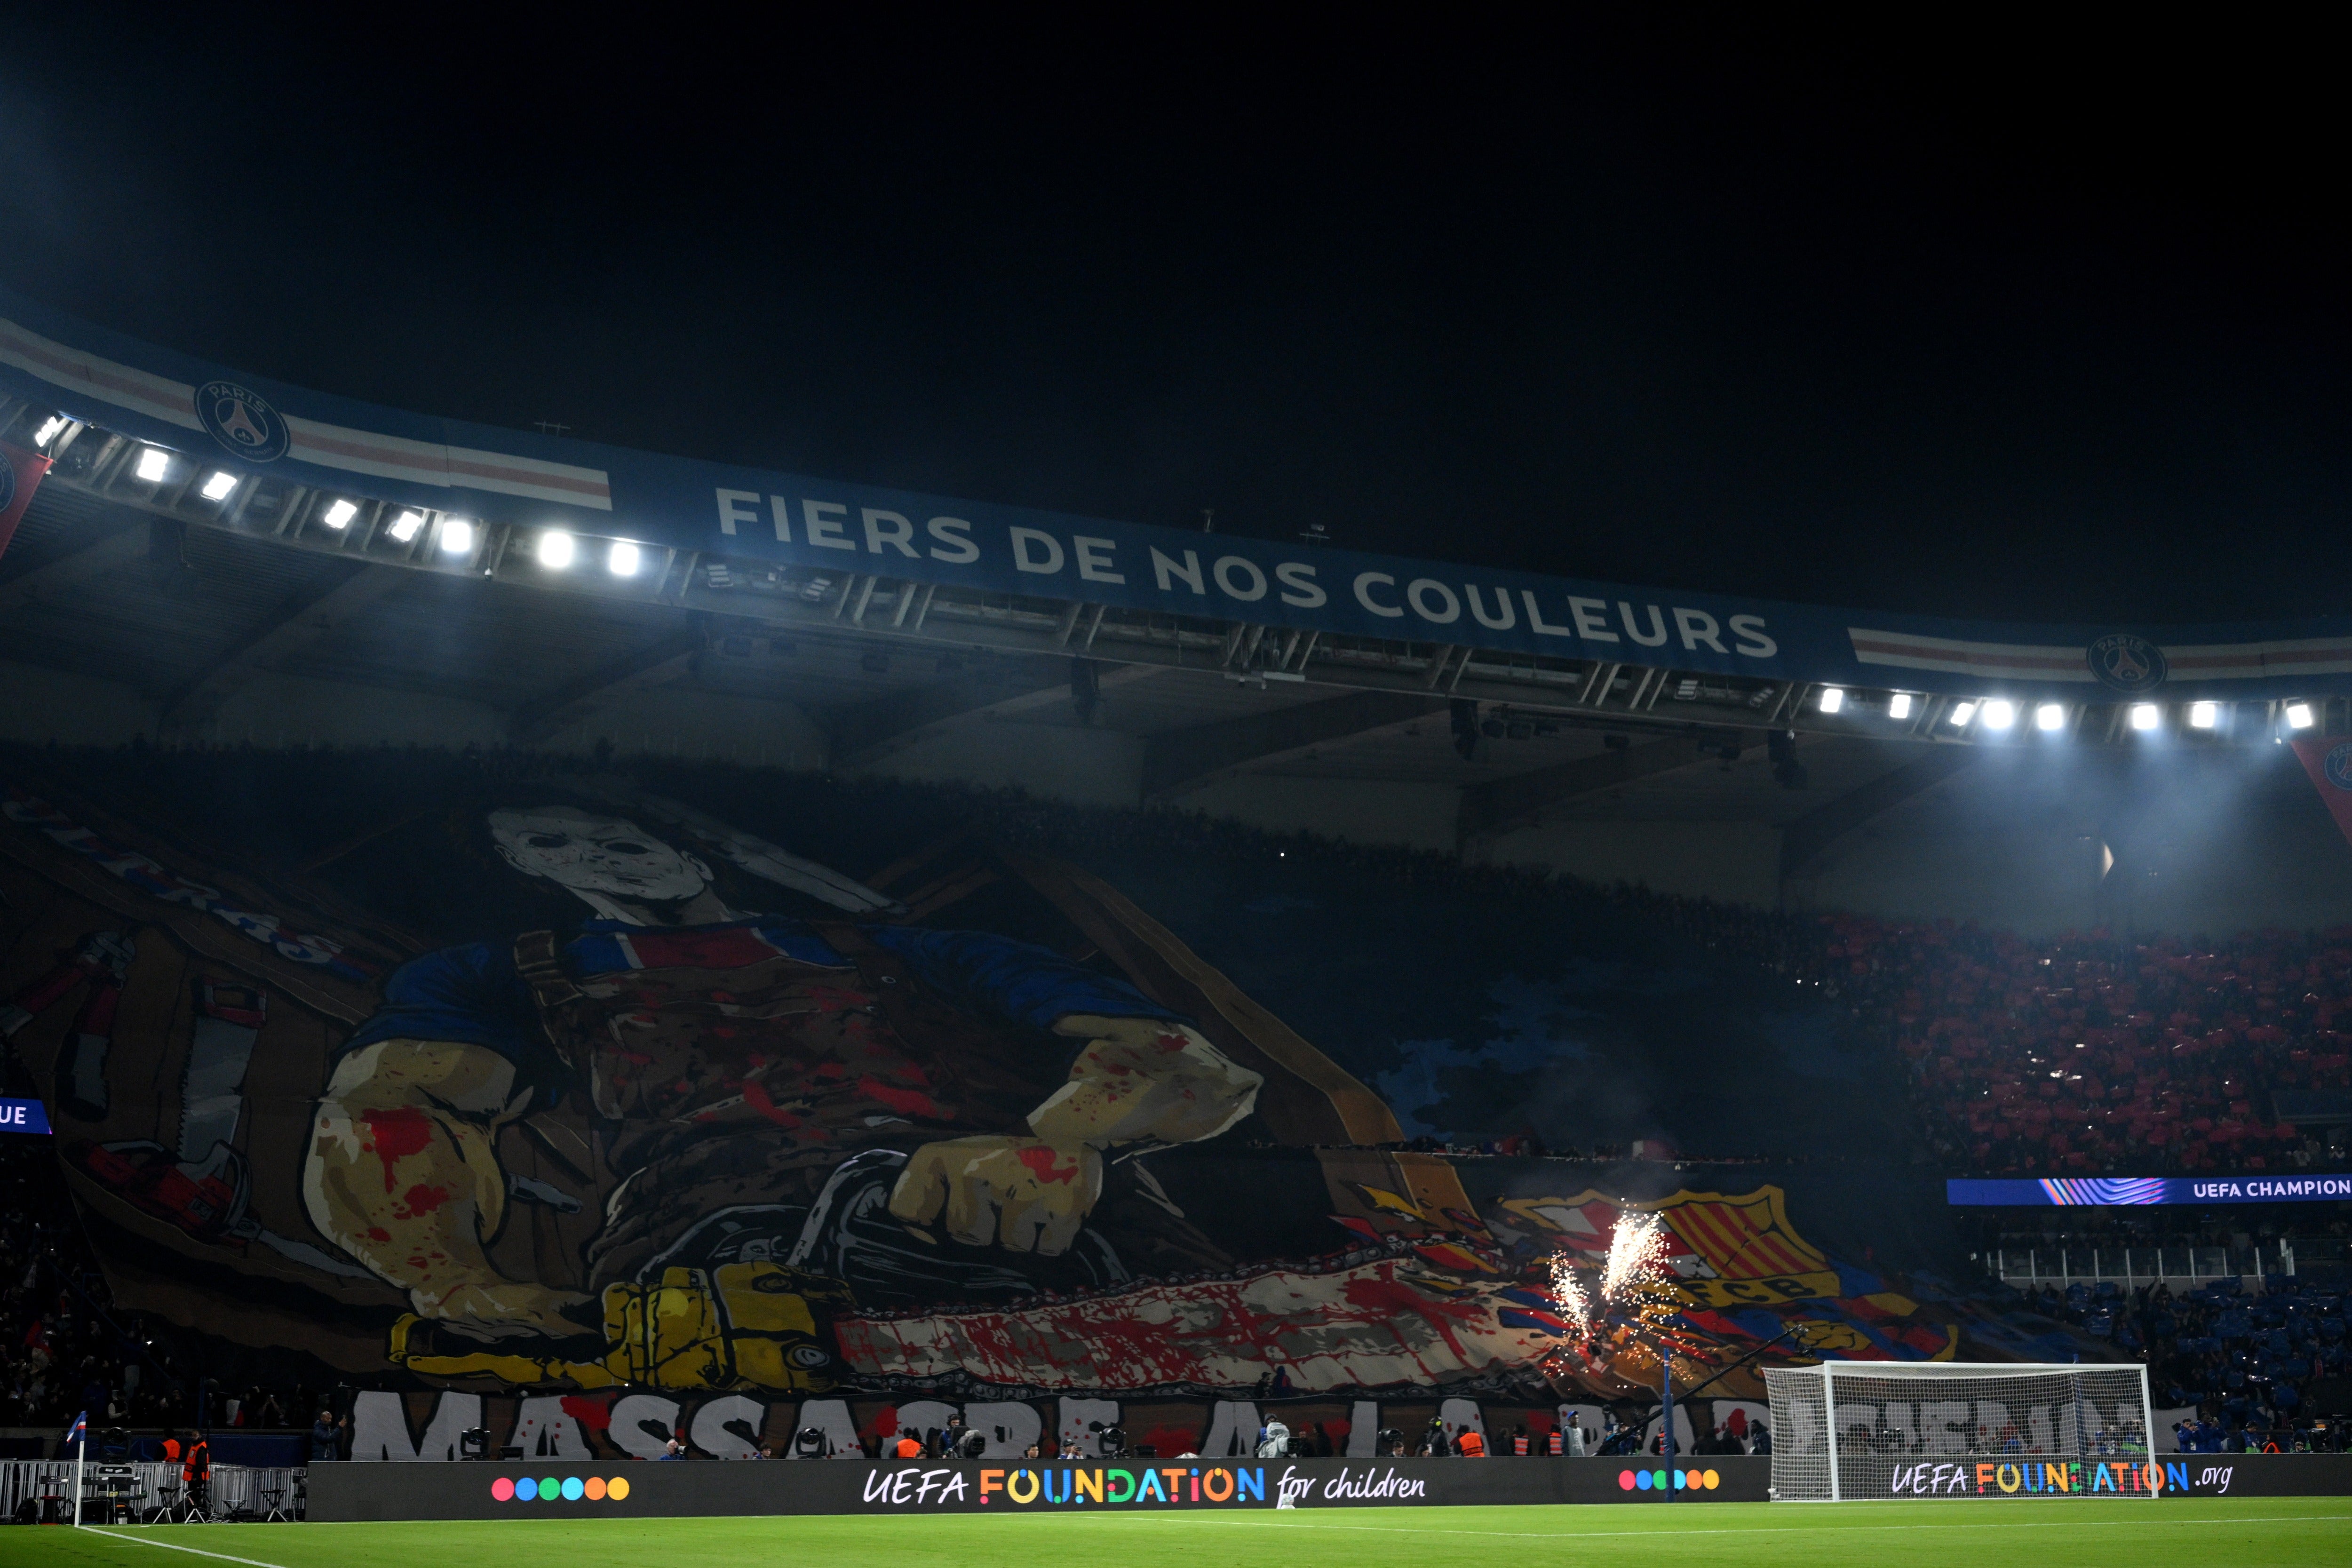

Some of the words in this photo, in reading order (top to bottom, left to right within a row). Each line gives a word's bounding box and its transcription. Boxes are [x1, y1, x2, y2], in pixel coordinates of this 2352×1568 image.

[208, 385, 267, 413] PARIS
[715, 487, 980, 565] FIERS
[1009, 526, 1125, 585] DE
[1150, 545, 1327, 609] NOS
[1353, 572, 1778, 659] COULEURS
[2194, 1183, 2241, 1198] UEFA
[2247, 1180, 2351, 1196] CHAMPION
[864, 1468, 969, 1504] UEFA
[1276, 1465, 1317, 1509] for
[1324, 1466, 1426, 1499] children
[1892, 1463, 1968, 1494] UEFA
[2195, 1466, 2233, 1494] .org
